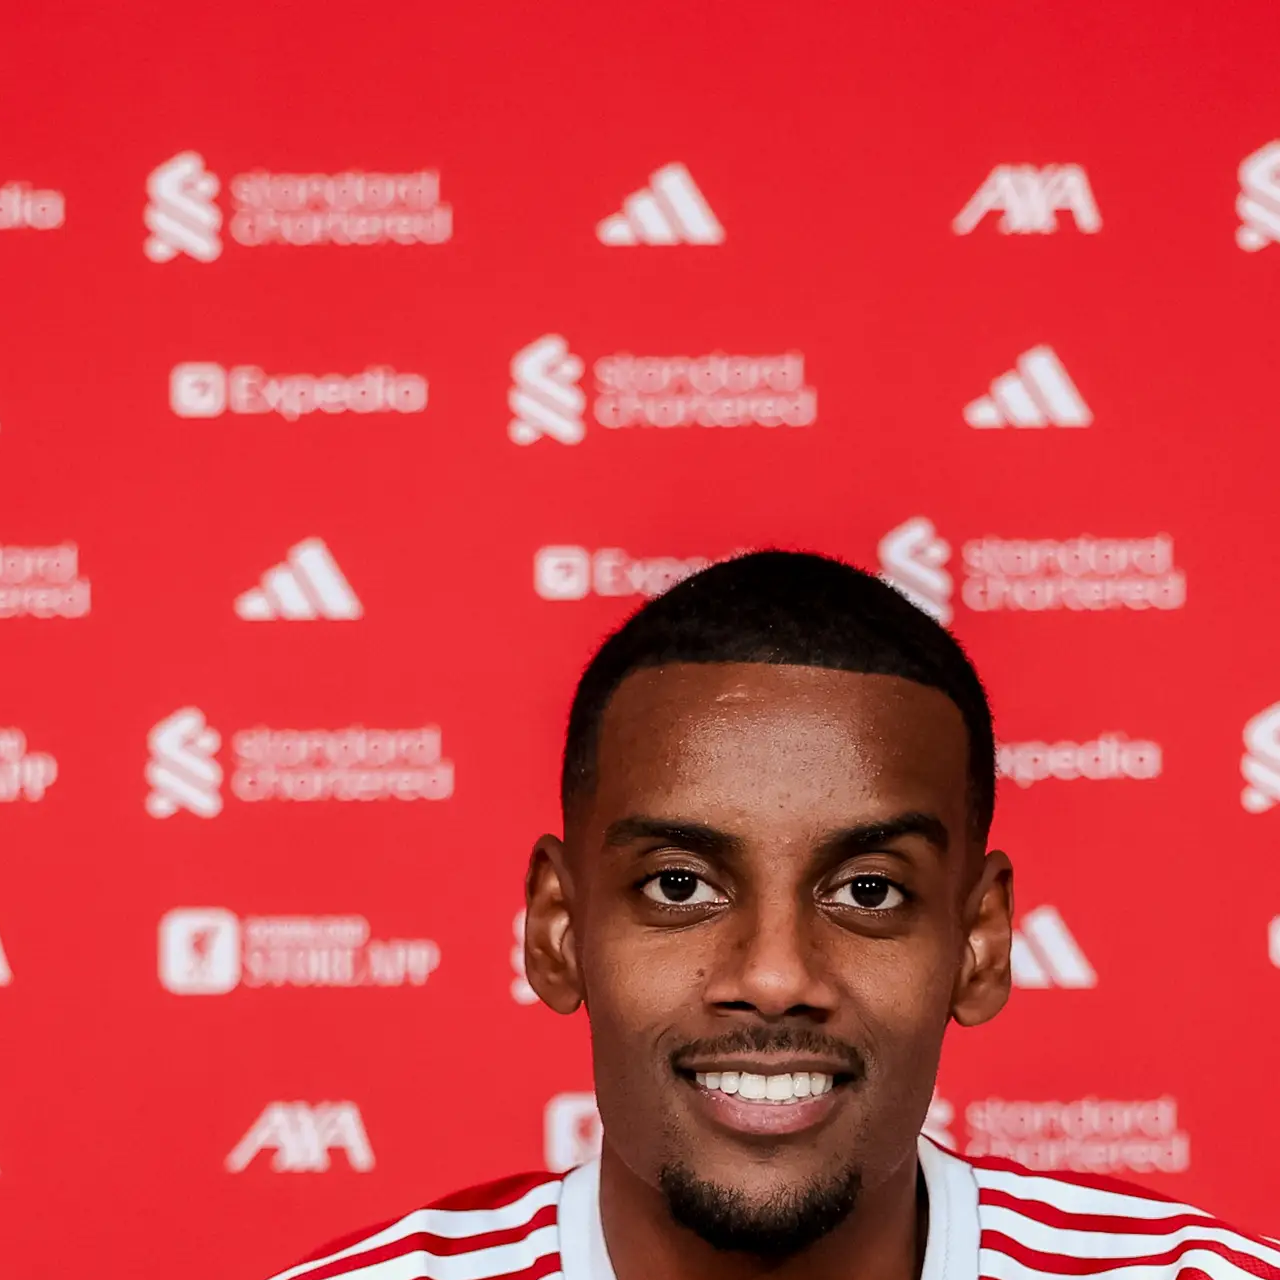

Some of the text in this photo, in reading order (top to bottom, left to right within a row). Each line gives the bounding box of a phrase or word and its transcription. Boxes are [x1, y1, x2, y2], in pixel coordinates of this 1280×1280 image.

[230, 171, 442, 209] standard
[952, 163, 1102, 235] AXA
[230, 207, 452, 246] chartered
[227, 365, 428, 420] Expedia
[594, 354, 806, 392] standard
[594, 390, 817, 428] chartered
[963, 535, 1174, 574] standard
[962, 572, 1186, 611] chartered
[233, 727, 444, 765] standard
[995, 732, 1163, 789] xpedia
[231, 763, 454, 801] chartered
[965, 1094, 1178, 1137] standard
[224, 1100, 376, 1173] AXA
